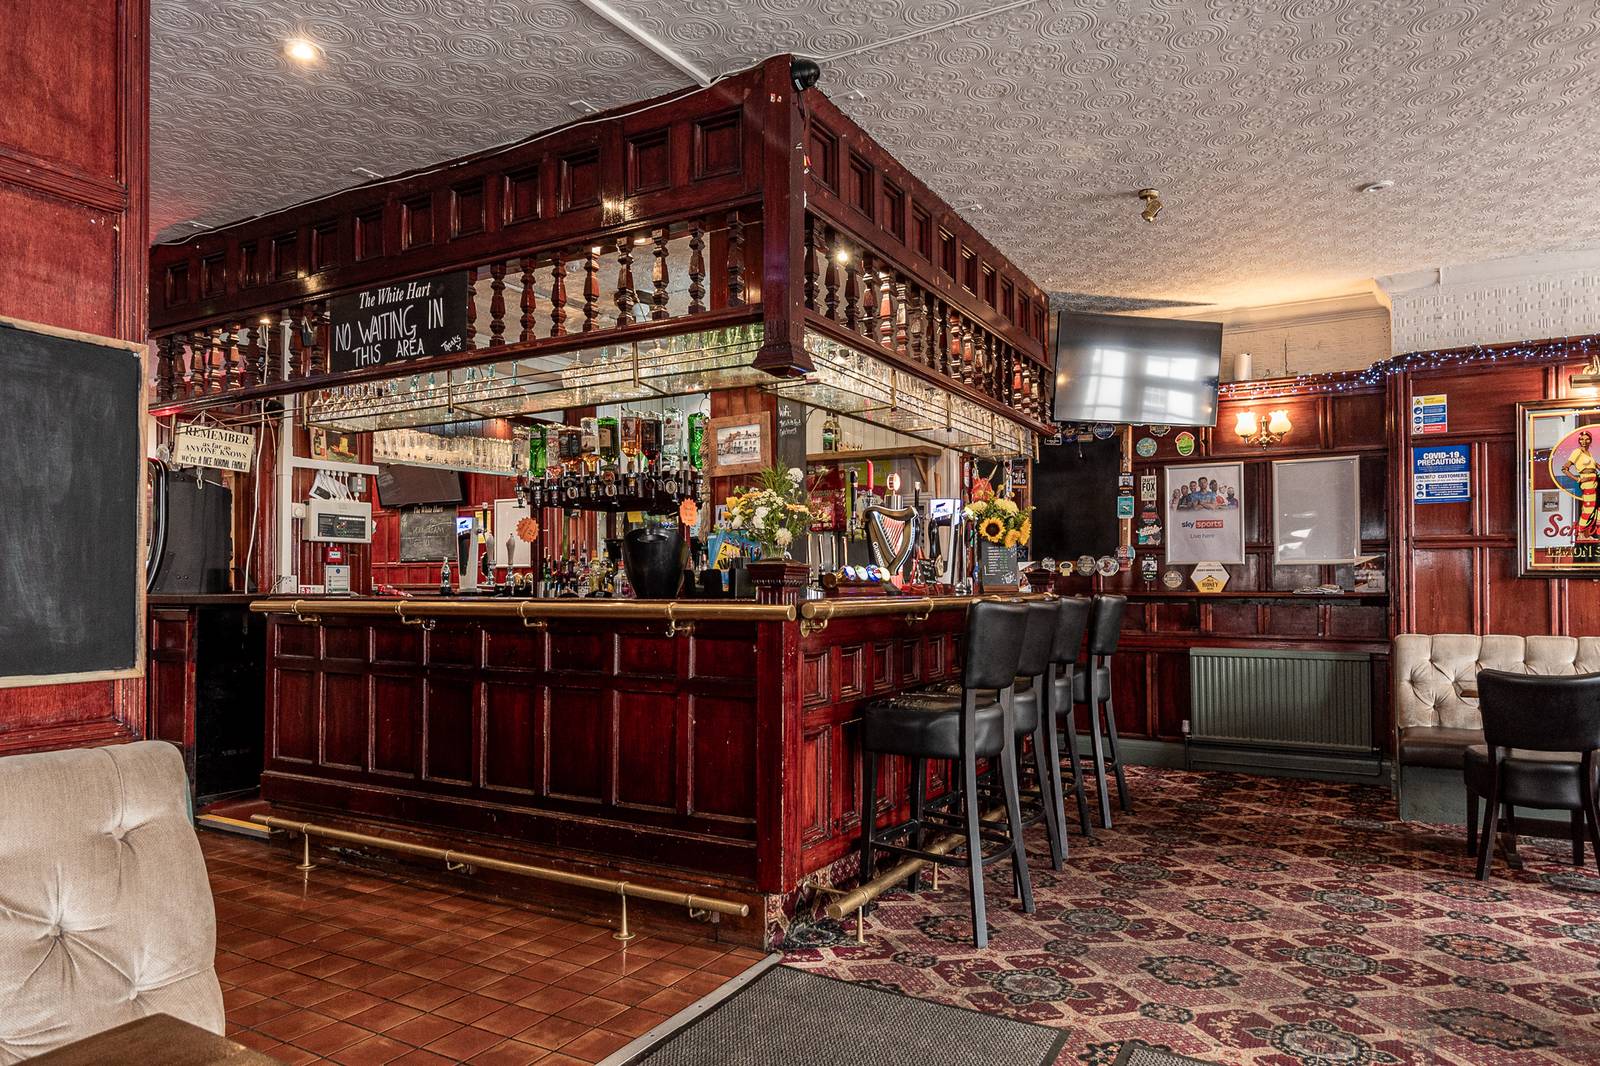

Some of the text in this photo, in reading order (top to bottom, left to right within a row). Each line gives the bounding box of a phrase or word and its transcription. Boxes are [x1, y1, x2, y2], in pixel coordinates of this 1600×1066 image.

[359, 281, 431, 309] The White Hart
[335, 297, 444, 352] NO WAITING IN
[352, 338, 425, 368] THIS AREA
[185, 427, 249, 445] REMEMBER
[186, 444, 247, 459] ANYONE KNOWS
[1423, 451, 1461, 460] COVID-19
[1417, 456, 1467, 467] PRECAUTIONS
[1142, 483, 1156, 492] FOX
[1181, 520, 1223, 529] sky sports
